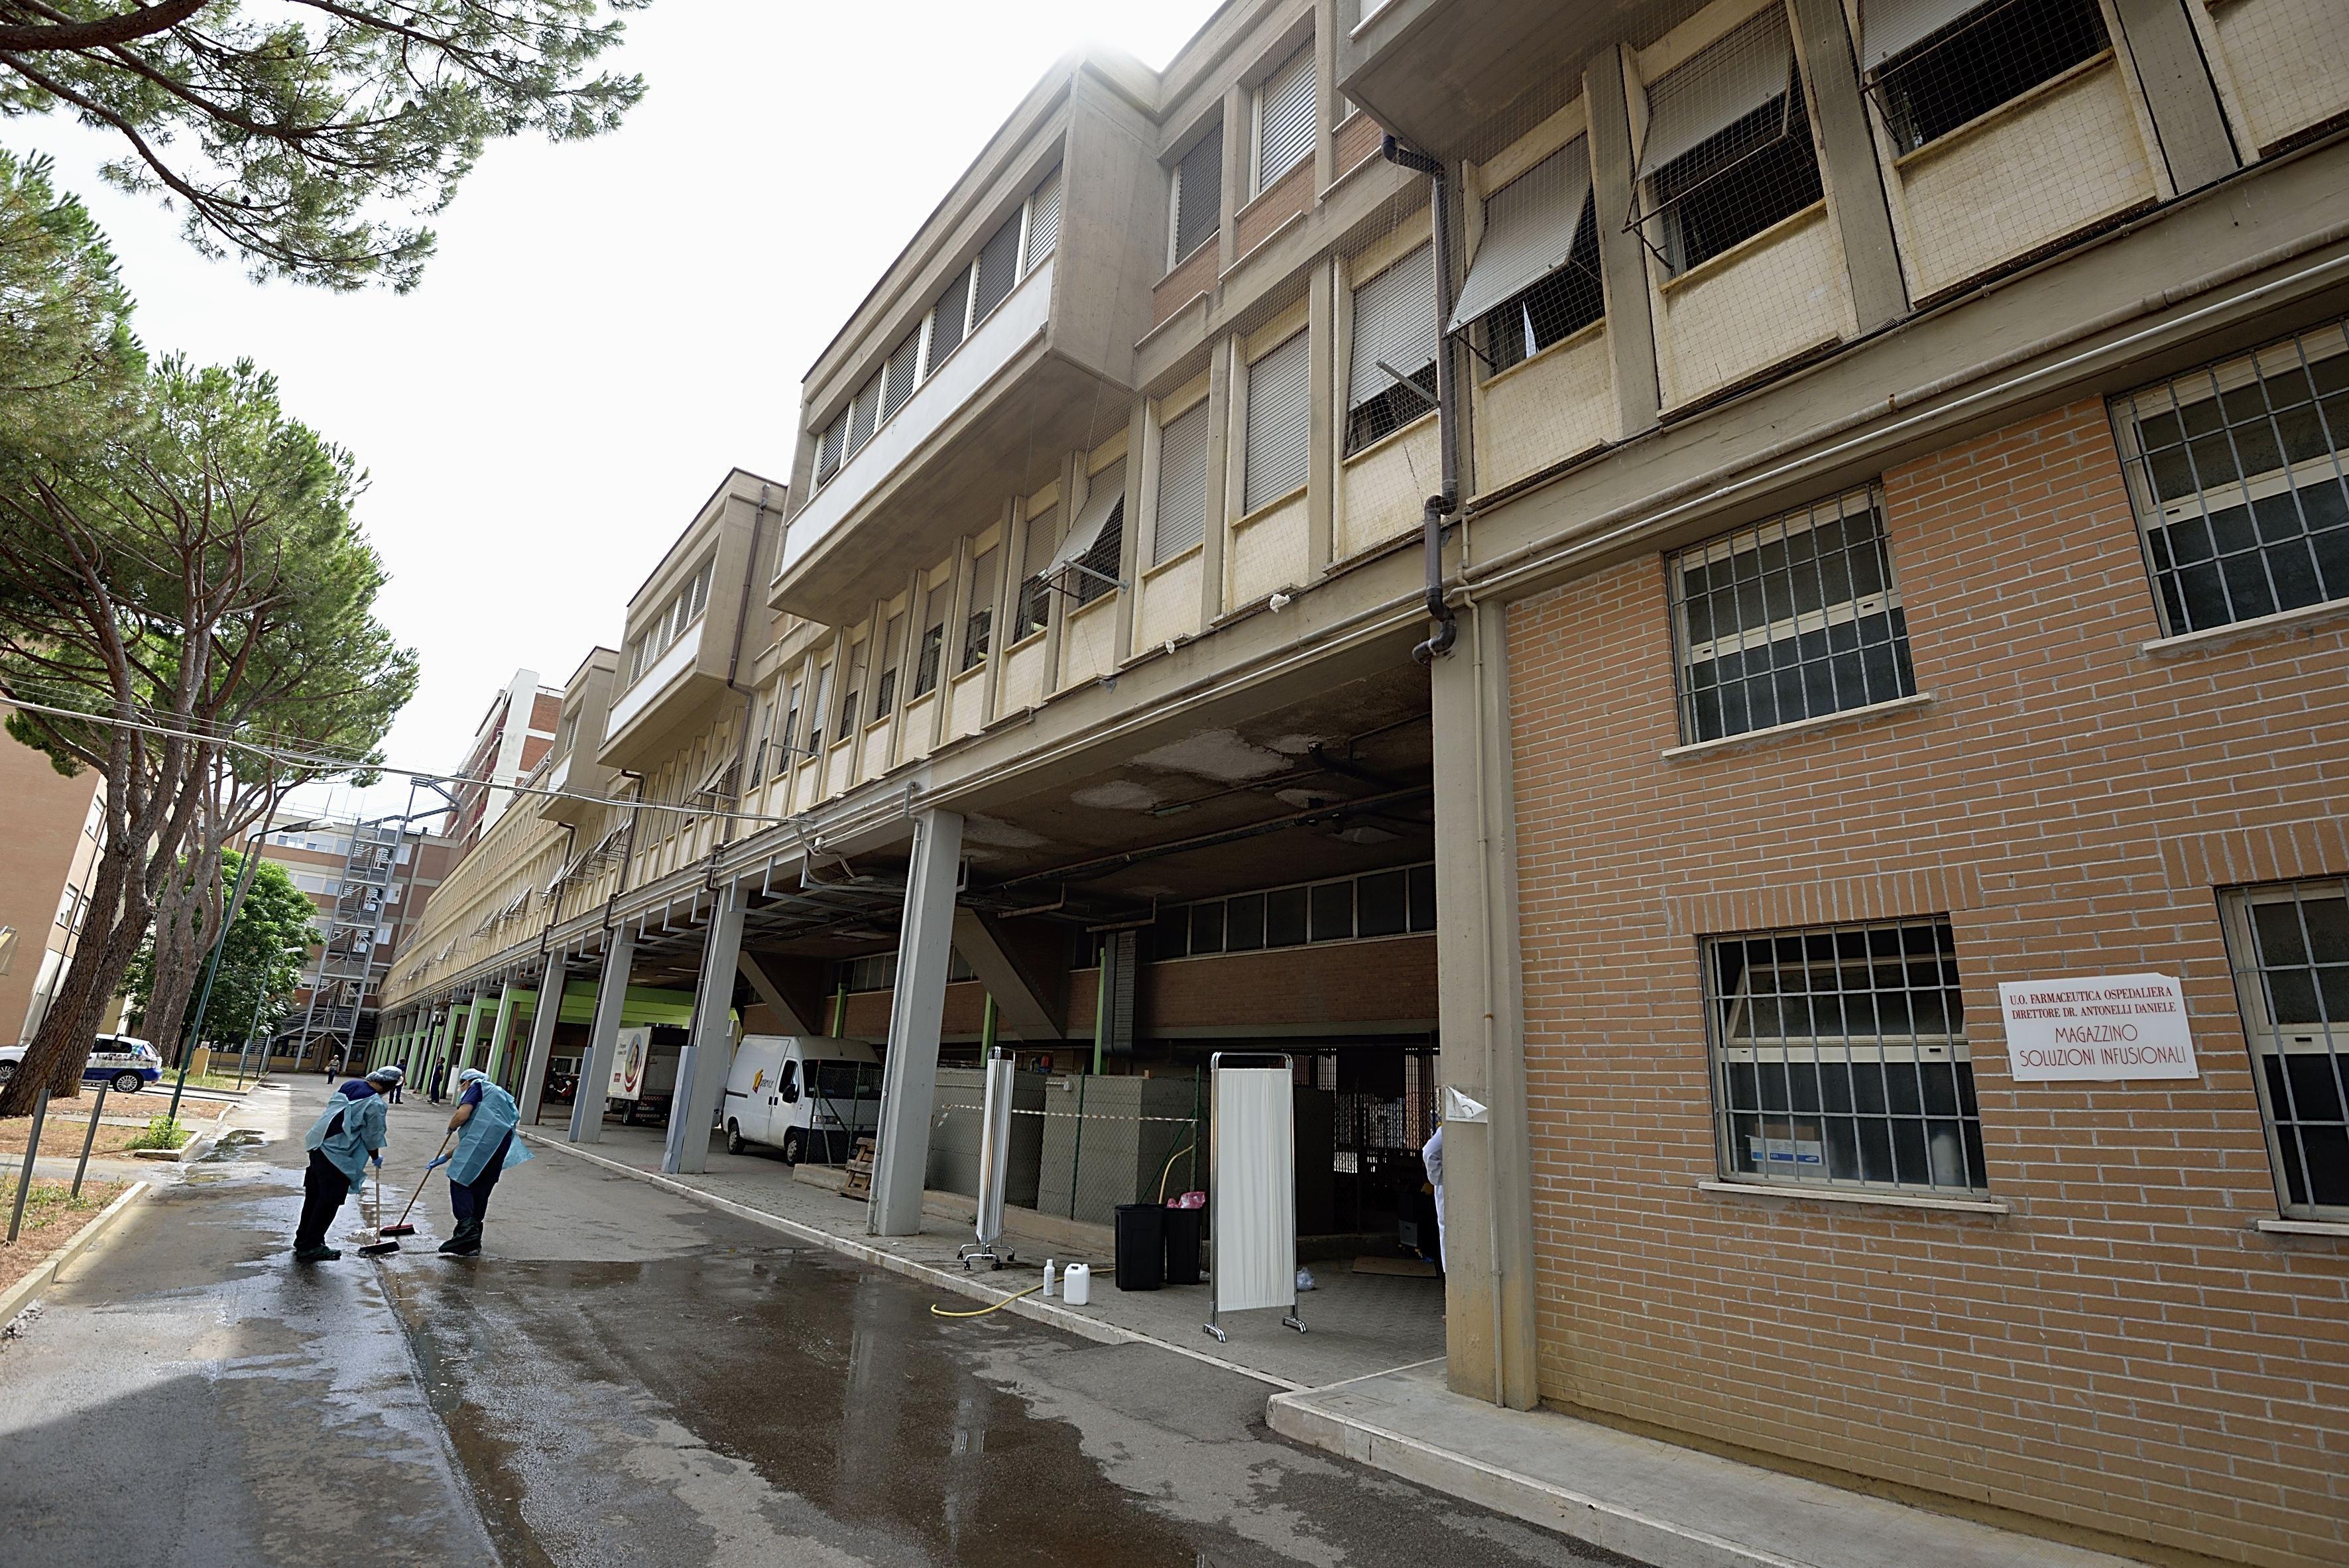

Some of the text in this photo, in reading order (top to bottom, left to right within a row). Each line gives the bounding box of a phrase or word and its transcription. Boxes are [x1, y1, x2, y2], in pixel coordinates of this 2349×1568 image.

[2010, 987, 2173, 1005] U.O. FARMACEUTICA OSPEDALIERA
[2012, 1002, 2176, 1019] DIRETTORE DR. ANTONELLI DANIELE
[2055, 1024, 2138, 1043] MAGAZZINO
[2019, 1046, 2186, 1067] SOLUZIONI INFUSIONALI
